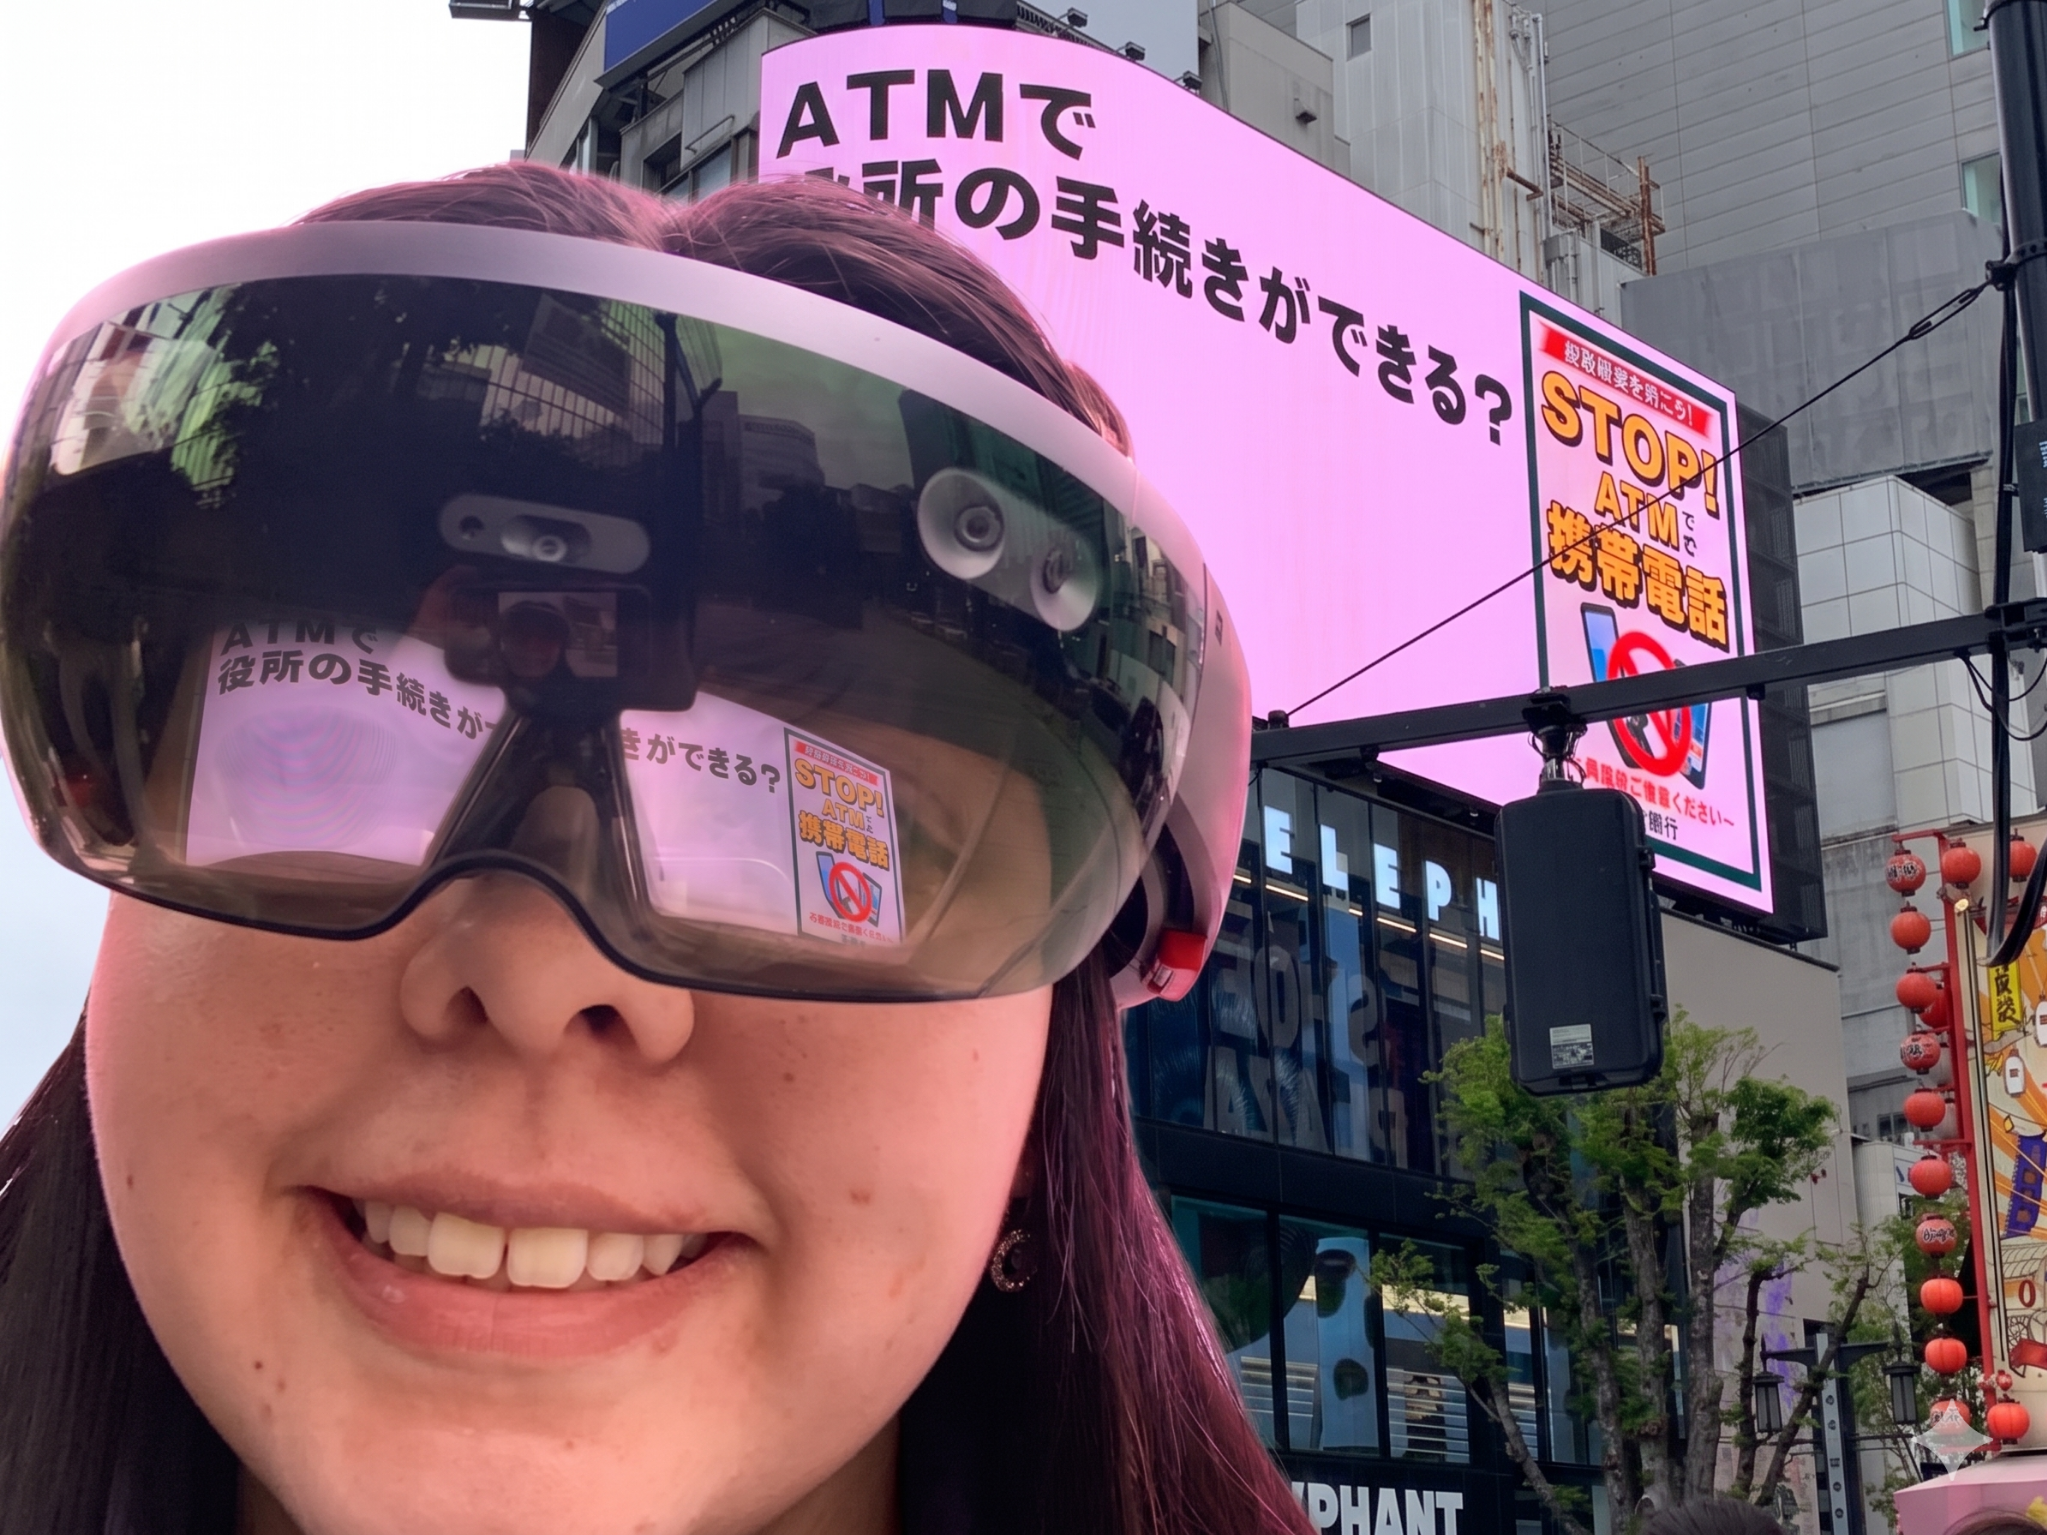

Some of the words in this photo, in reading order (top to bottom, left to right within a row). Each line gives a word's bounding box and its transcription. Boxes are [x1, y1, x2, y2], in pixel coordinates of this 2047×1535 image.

[776, 69, 1096, 160] ATMで
[803, 158, 1513, 446] 所の手続きができる?
[1541, 370, 1720, 520] STOP!
[1594, 471, 1680, 551] ATM
[1546, 499, 1730, 654] 携帯電話
[217, 649, 499, 740] 役所の手続きが
[795, 758, 884, 818] STOP!
[822, 798, 865, 830] ATM
[1291, 1481, 1464, 1535] PHANT
